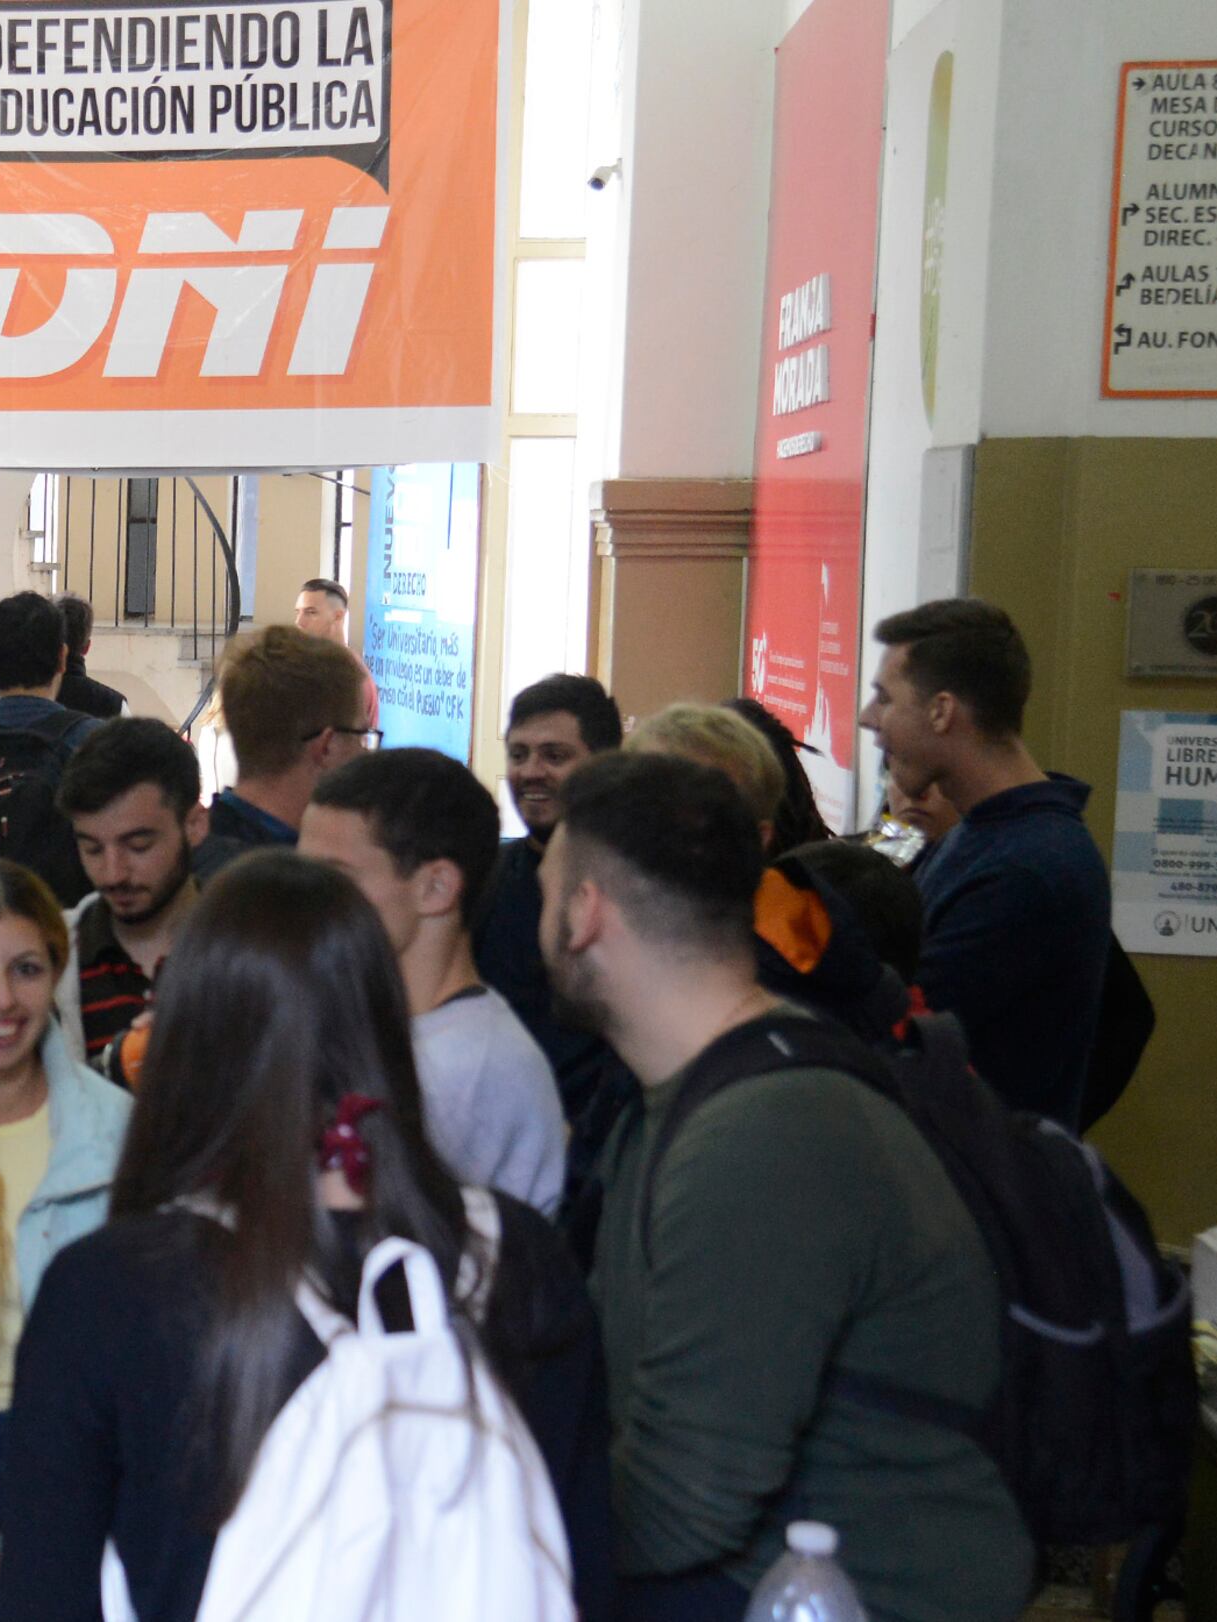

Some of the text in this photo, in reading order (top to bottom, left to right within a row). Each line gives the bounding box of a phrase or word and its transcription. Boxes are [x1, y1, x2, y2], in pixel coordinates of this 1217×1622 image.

[317, 7, 375, 68] LA
[1151, 73, 1206, 91] AULA
[209, 73, 376, 134] PÚBLICA
[1150, 97, 1207, 114] MESA
[1149, 120, 1217, 138] CURSO
[1145, 207, 1189, 223] SEC.
[1144, 229, 1212, 247] DIREC.
[1141, 265, 1209, 282] AULAS
[1166, 747, 1217, 763] LIBRE
